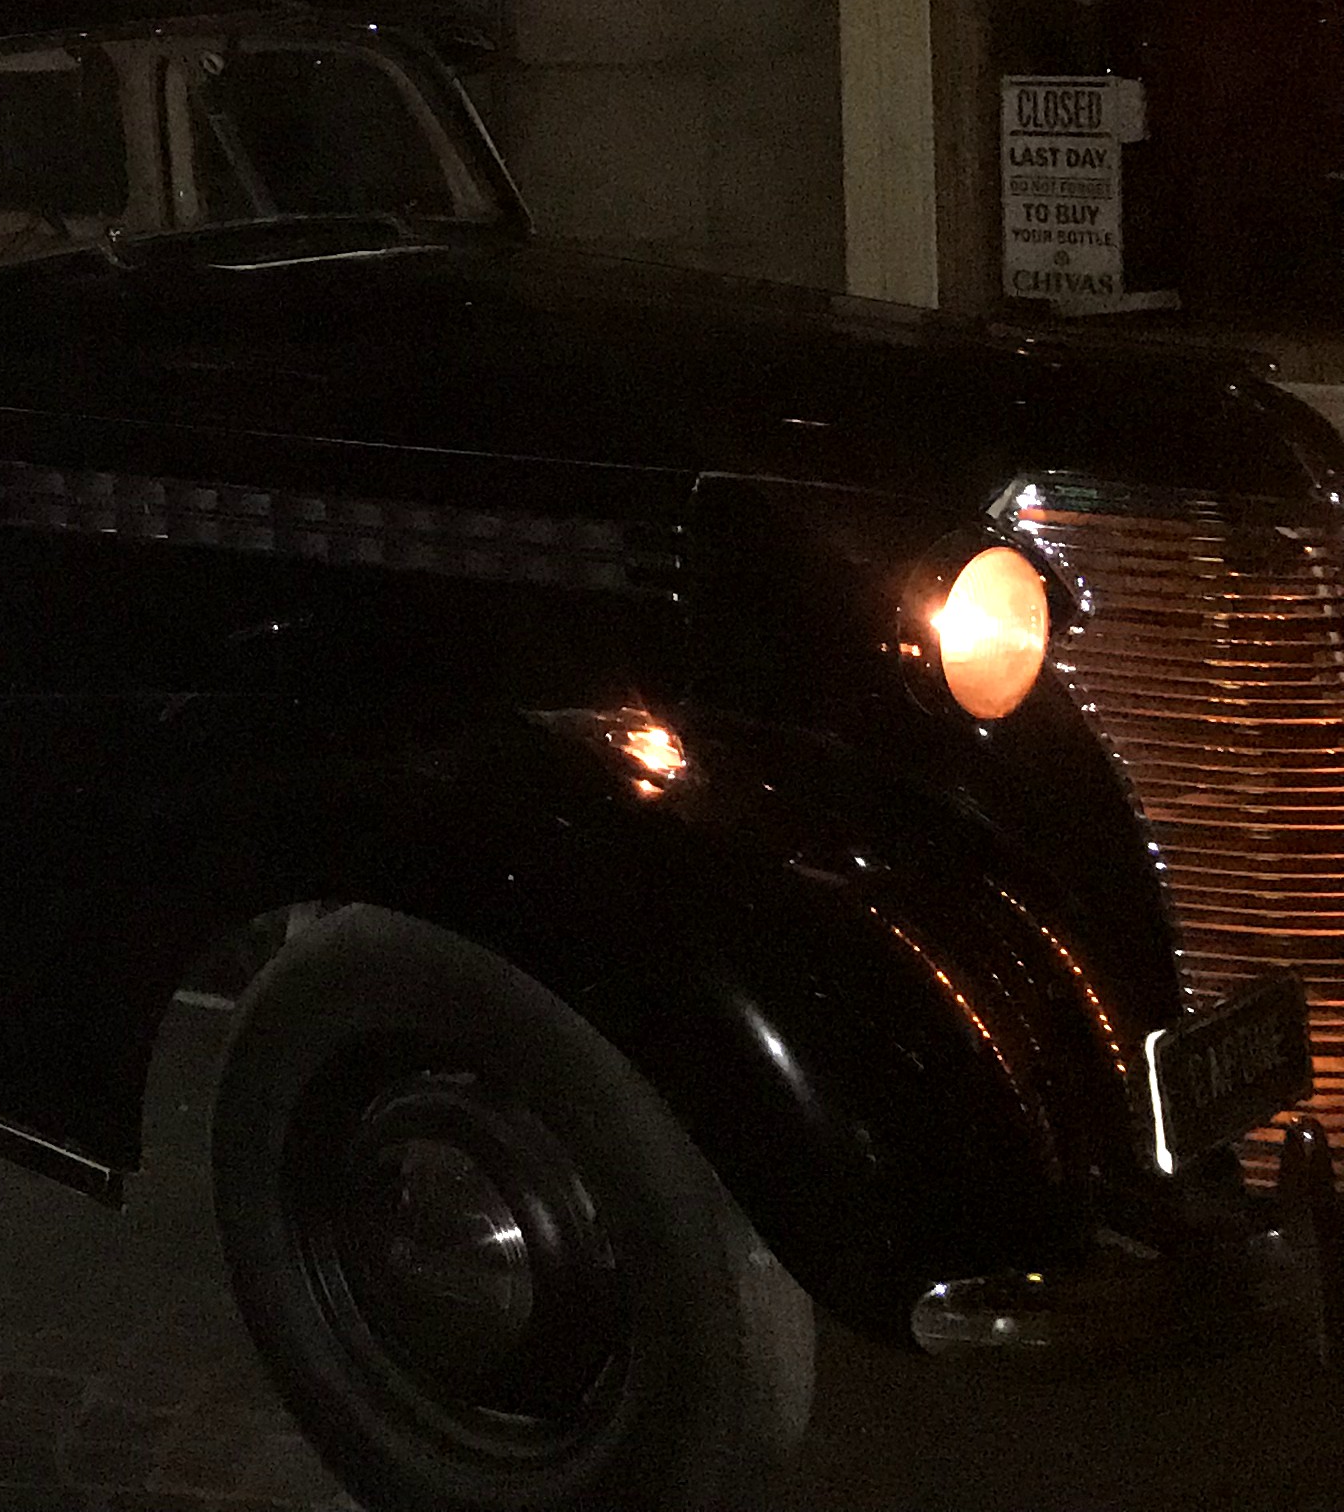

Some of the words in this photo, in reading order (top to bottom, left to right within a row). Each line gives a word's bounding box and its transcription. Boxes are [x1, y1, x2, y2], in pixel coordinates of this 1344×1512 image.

[1018, 89, 1101, 128] CLOSED
[1010, 147, 1059, 167] LAST
[1023, 203, 1048, 223] TO
[1055, 204, 1099, 225] BUY
[1011, 229, 1052, 243] YOUR
[1012, 270, 1113, 294] CHIVAS
